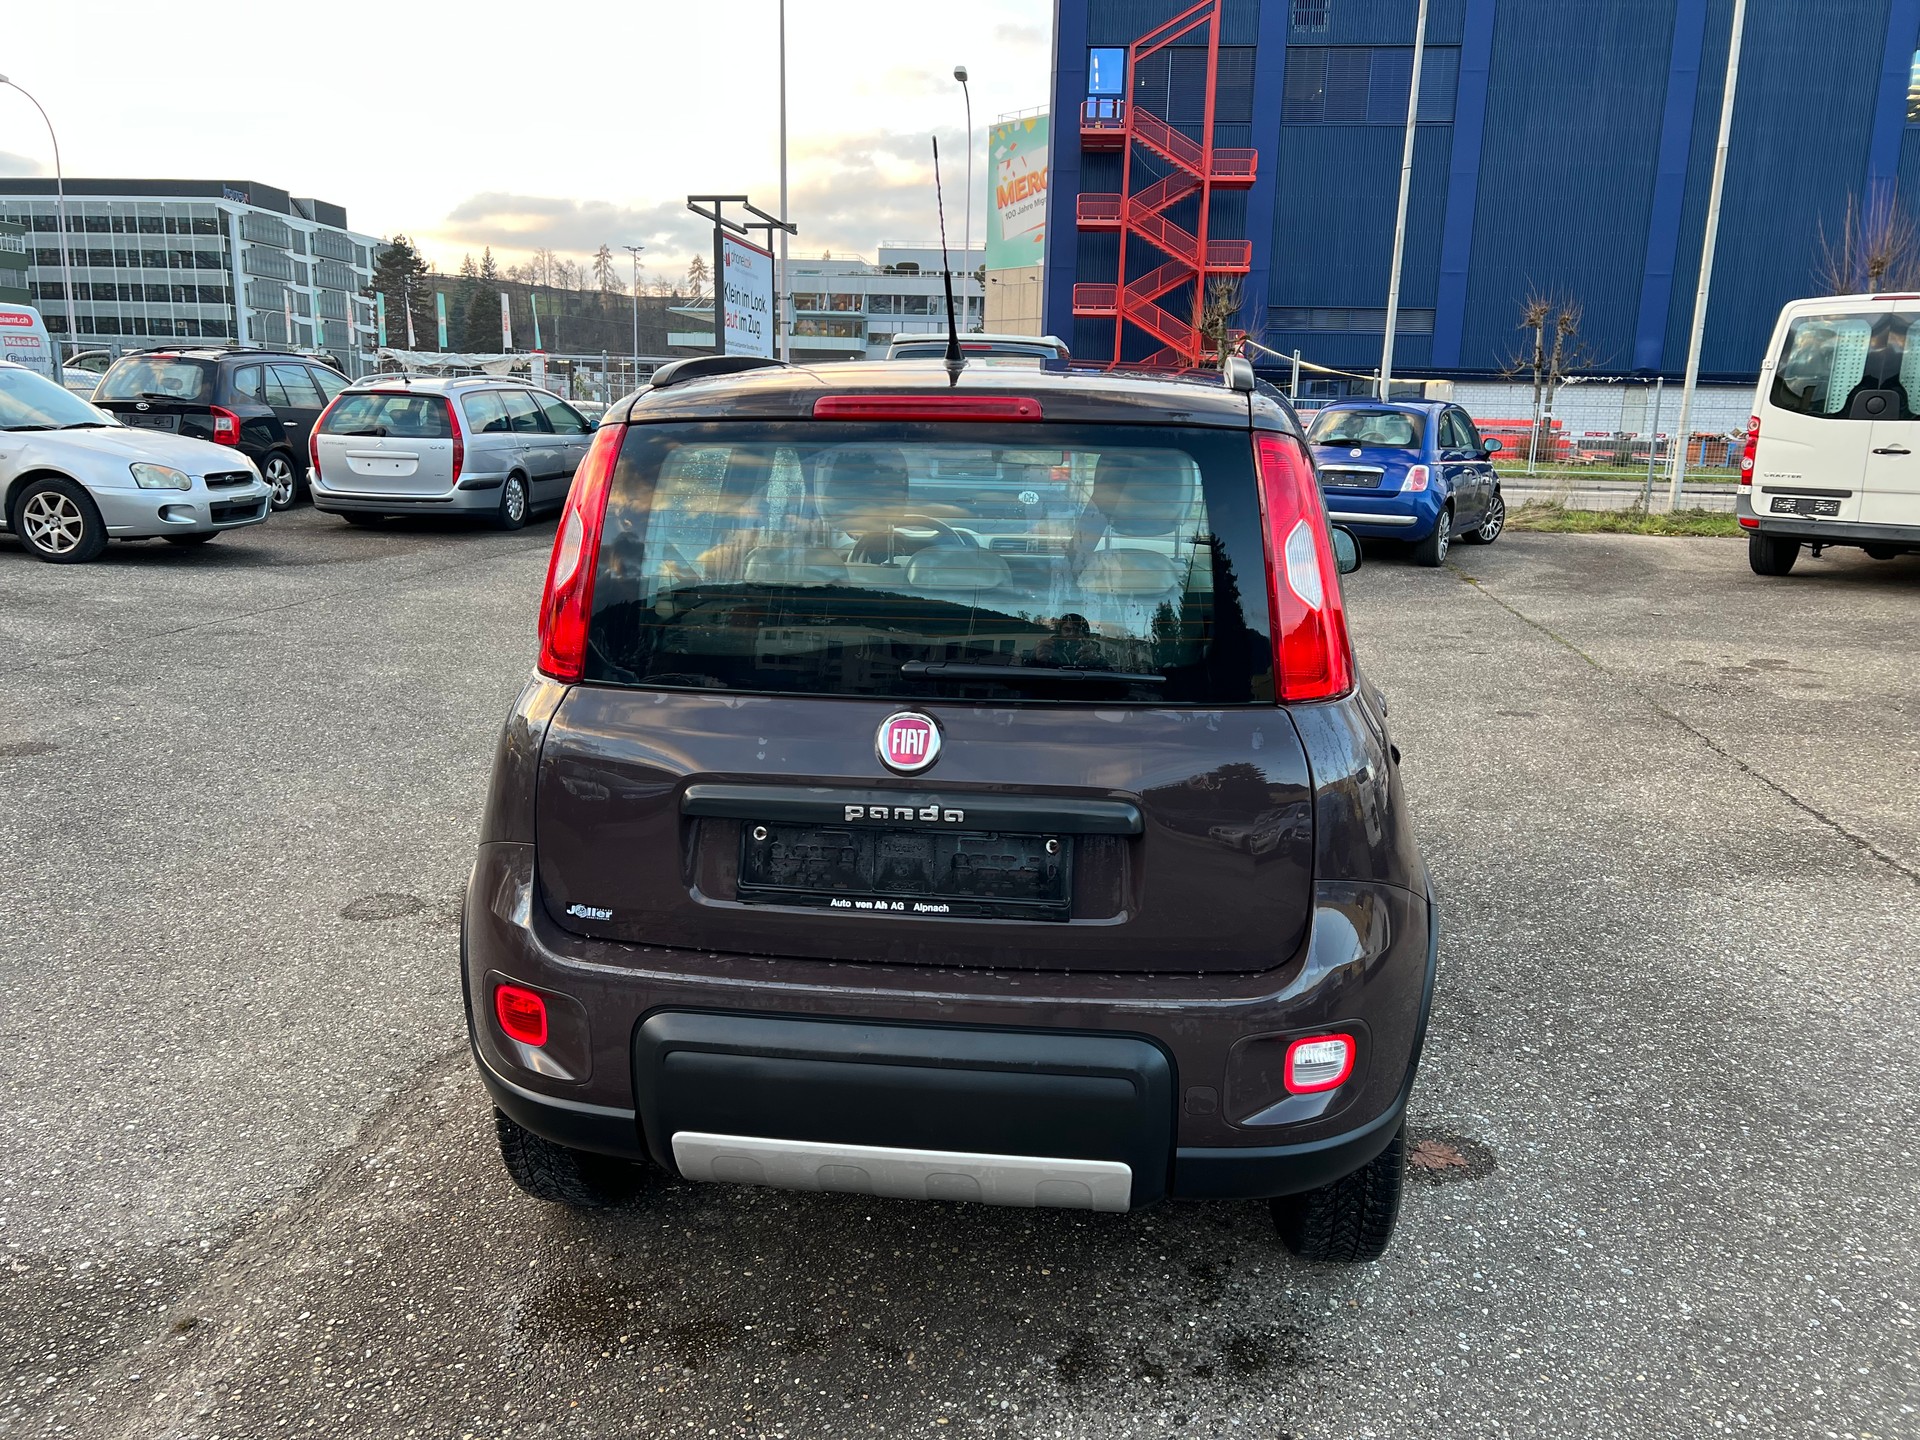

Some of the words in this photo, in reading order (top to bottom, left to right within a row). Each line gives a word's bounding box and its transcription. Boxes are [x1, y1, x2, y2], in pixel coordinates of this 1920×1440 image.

[1005, 209, 1017, 221] 100
[1017, 202, 1034, 214] Jahre
[724, 282, 741, 306] Klein
[742, 286, 750, 308] im
[751, 290, 768, 314] Look,
[724, 306, 738, 329] laut
[739, 310, 748, 332] im
[4, 337, 39, 346] Miele
[891, 728, 928, 755] FIAT
[844, 805, 964, 823] panda
[830, 898, 852, 908] Auto
[855, 901, 873, 909] von
[874, 900, 888, 910] Ah
[890, 901, 905, 910] AG
[913, 902, 950, 913] Alpnach
